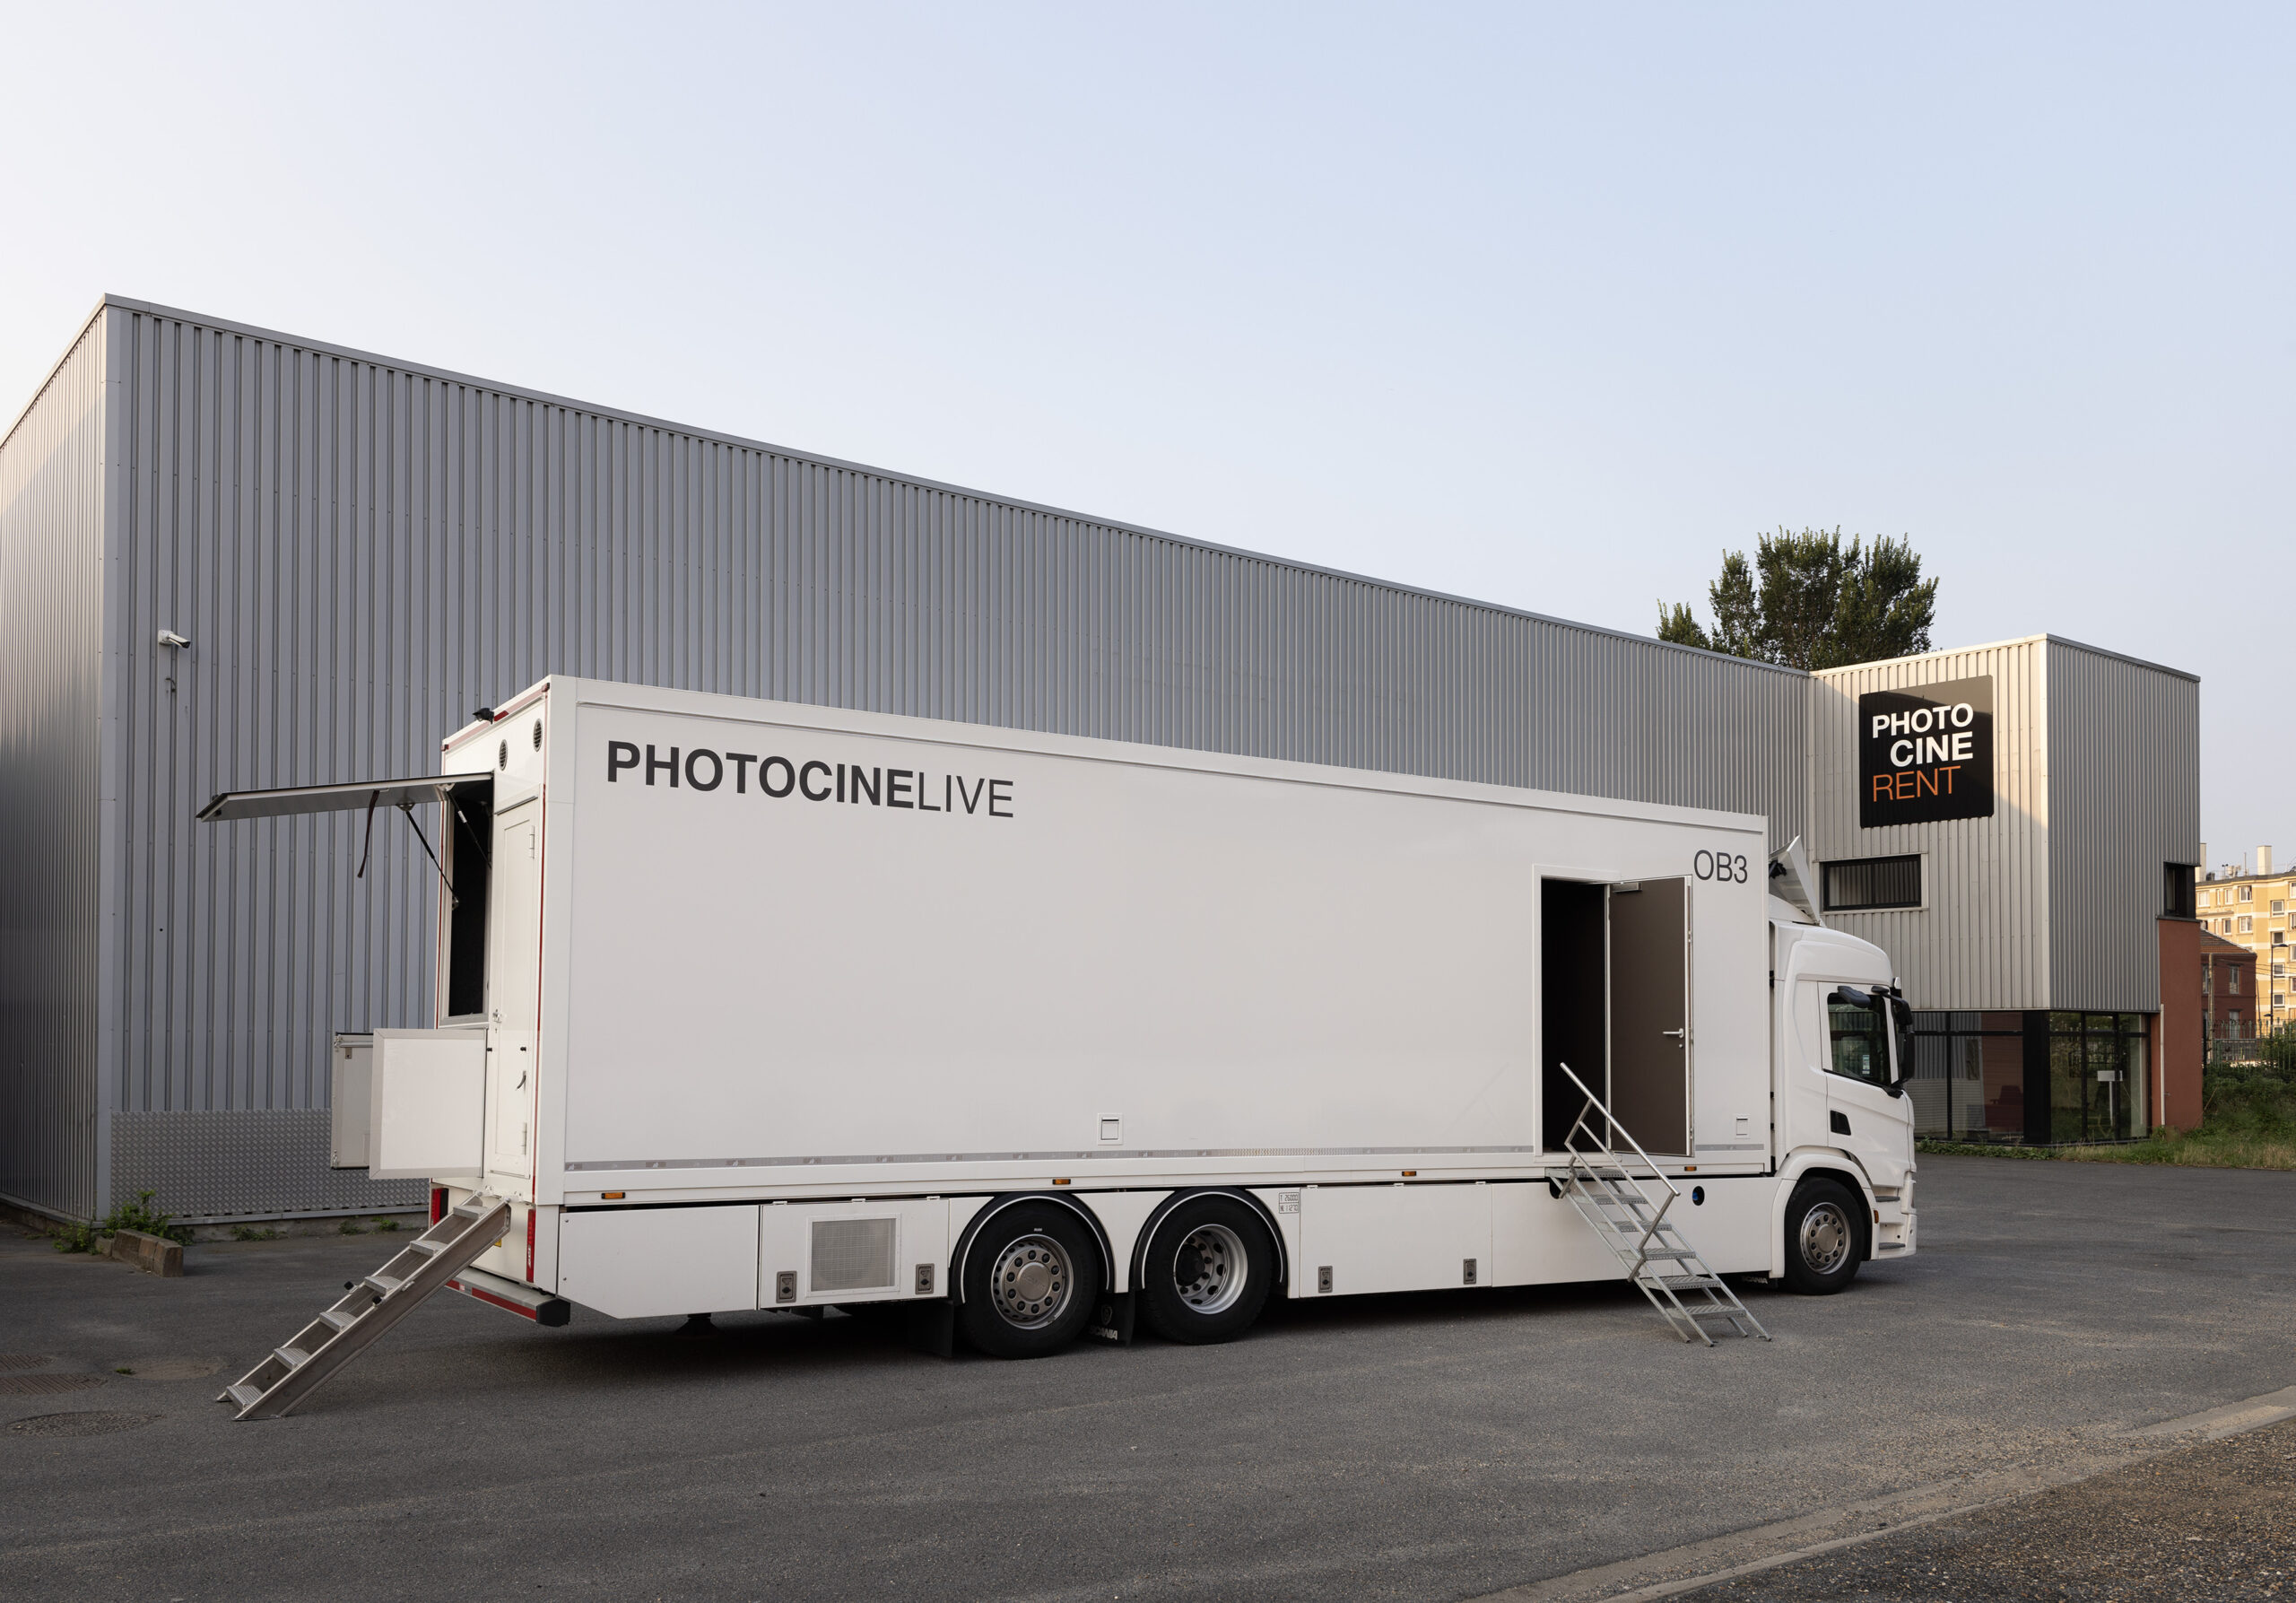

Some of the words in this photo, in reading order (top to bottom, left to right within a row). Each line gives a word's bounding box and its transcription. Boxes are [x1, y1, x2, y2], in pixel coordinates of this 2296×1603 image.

[1872, 702, 1974, 739] PHOTO
[1890, 731, 1974, 768] CINE
[606, 740, 1014, 818] PHOTOCINELIVE
[1873, 765, 1961, 802] RENT
[1693, 849, 1748, 884] OB3
